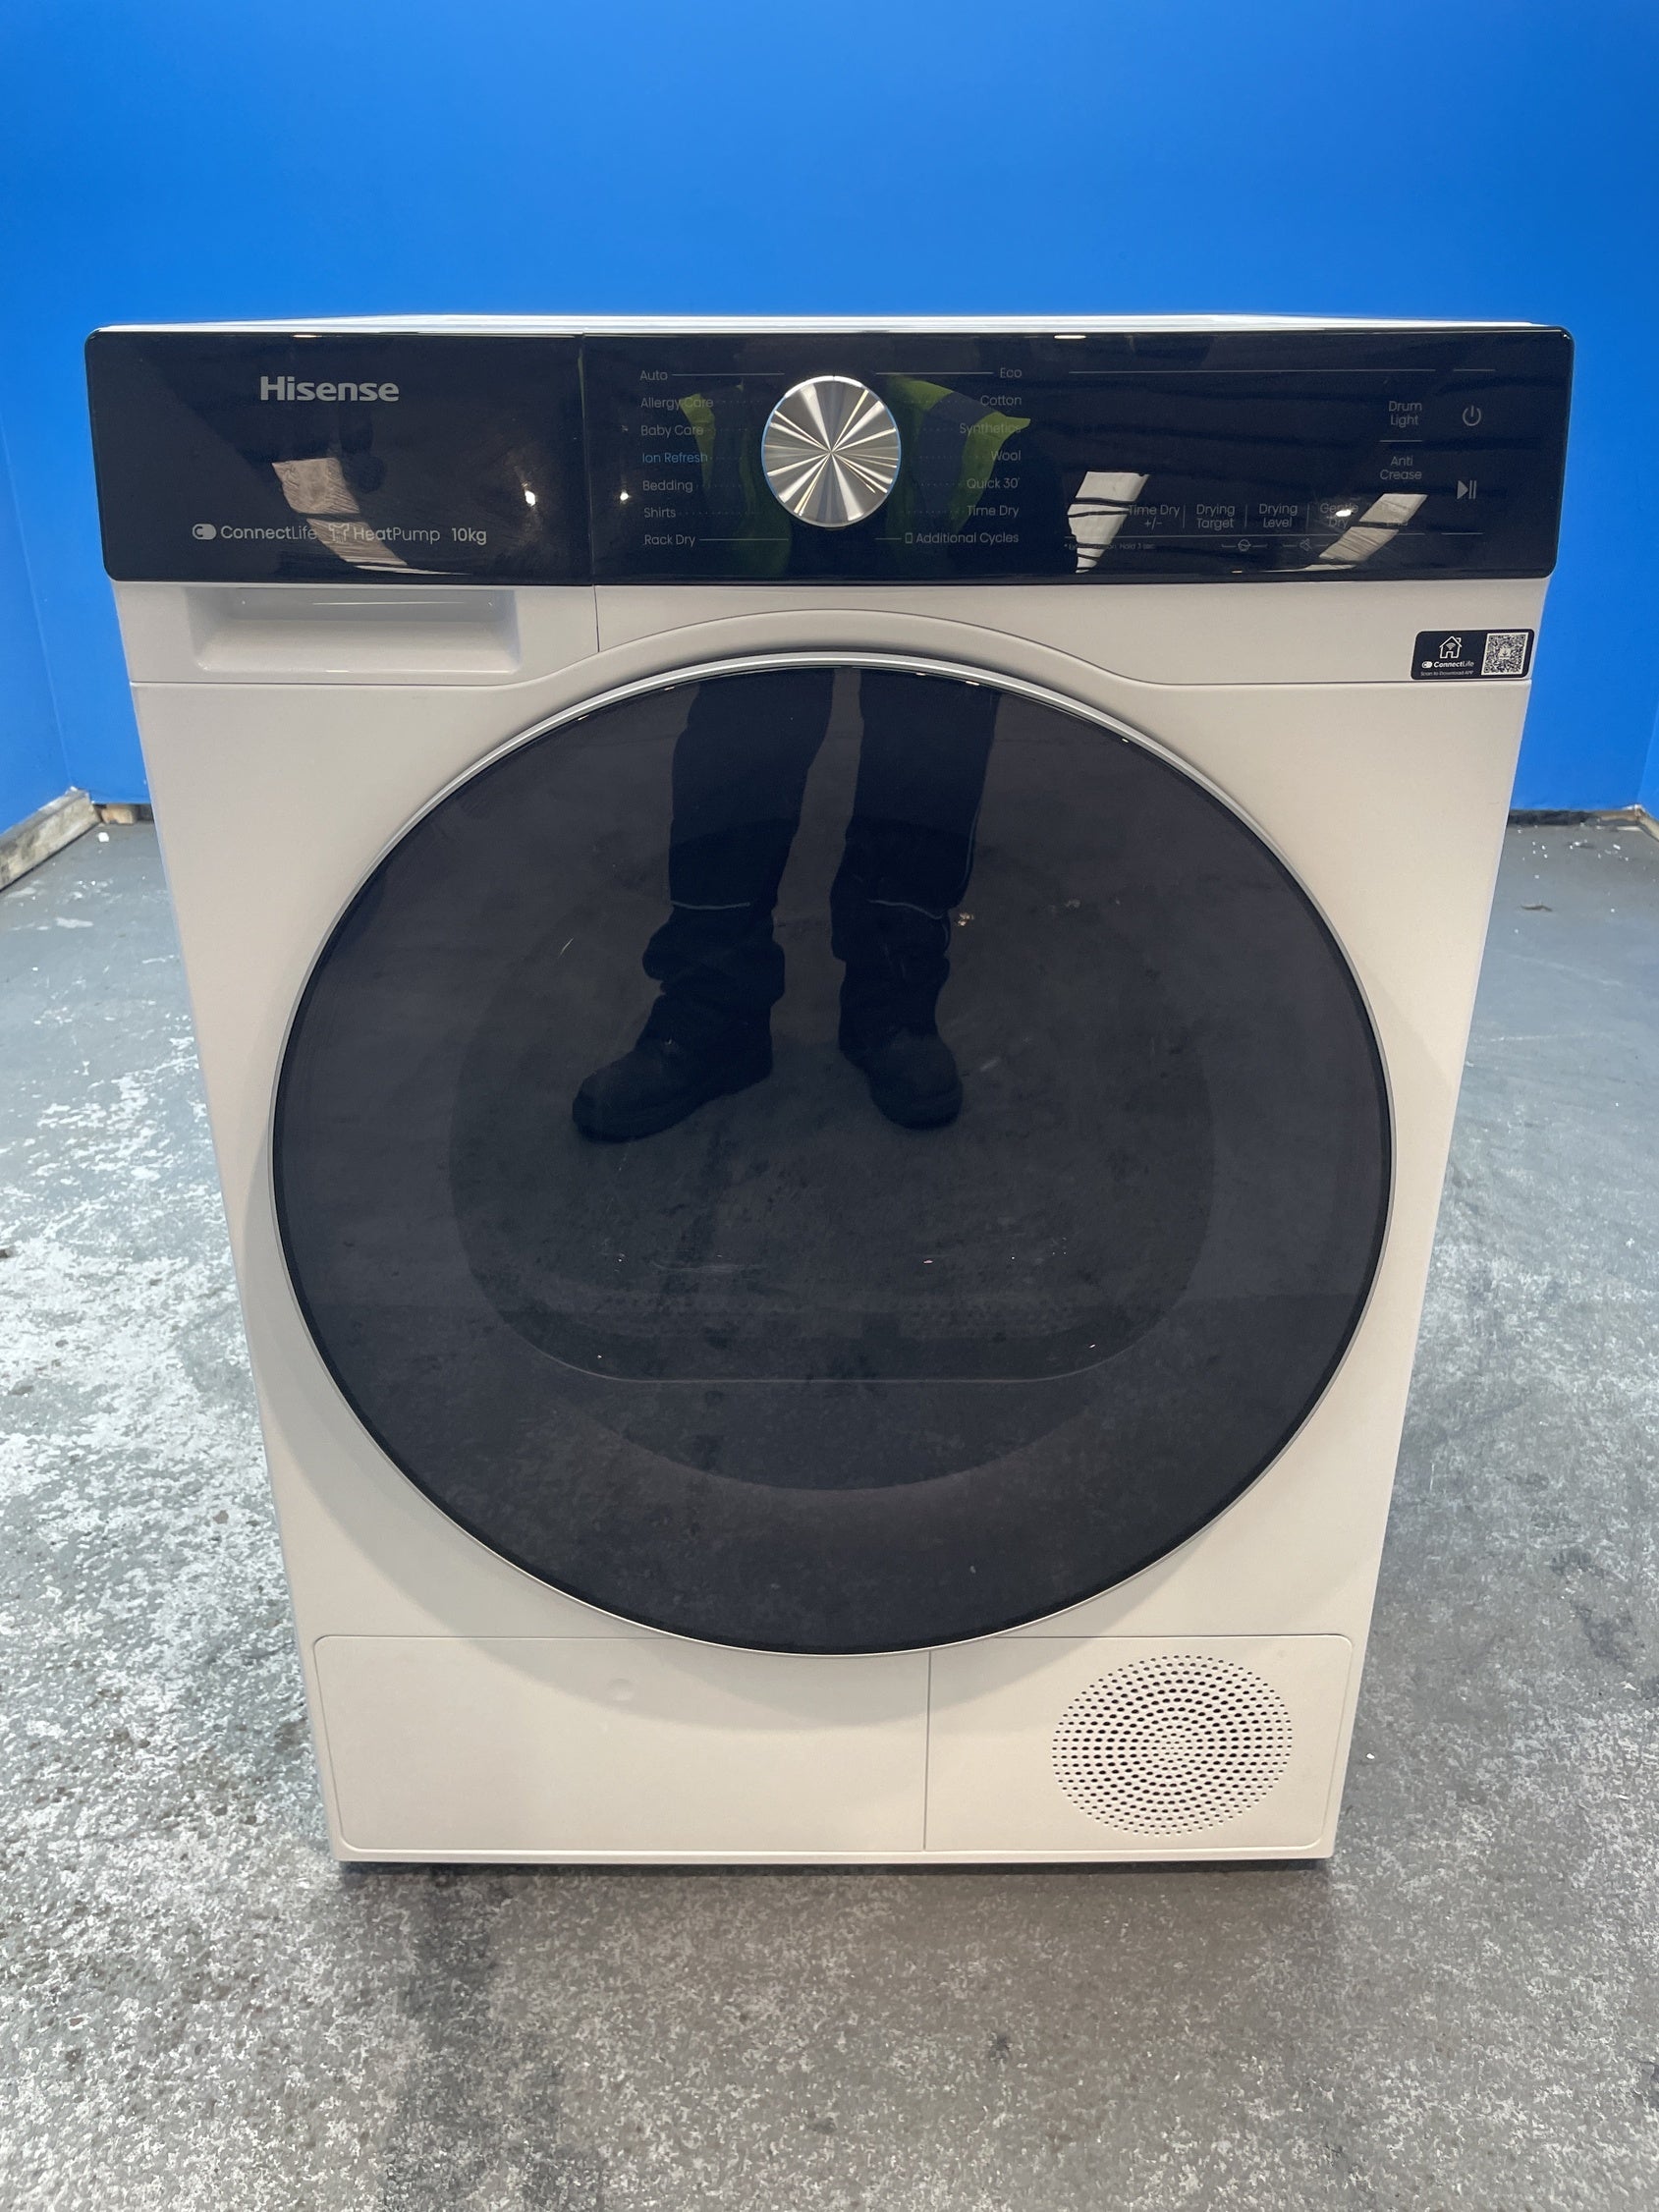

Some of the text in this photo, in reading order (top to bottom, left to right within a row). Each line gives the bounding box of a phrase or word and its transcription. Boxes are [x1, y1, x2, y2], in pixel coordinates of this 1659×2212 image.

[639, 370, 668, 381] Auto
[1000, 367, 1023, 378] Eco
[259, 375, 400, 402] Hisense
[641, 397, 714, 411] Allergy Care
[980, 395, 1022, 407] Cotton
[1388, 401, 1422, 412] Drum
[1390, 415, 1419, 428] Light
[640, 424, 704, 438] Baby Care
[960, 422, 1022, 435] Synthetics
[642, 452, 708, 463] Ion Refresh
[991, 450, 1022, 462] Wool
[1390, 456, 1413, 467] Anti
[1379, 470, 1422, 479] Crease
[642, 479, 693, 493] Bedding
[967, 478, 1000, 489] Quick
[643, 507, 676, 519] Shirts
[967, 505, 1019, 518] Time Dry
[1129, 504, 1181, 518] Time Dry
[1196, 503, 1236, 517] Drying
[1258, 503, 1298, 516] Drying
[1197, 518, 1234, 531] Target
[1263, 517, 1293, 527] Level
[1328, 518, 1350, 528] Dry
[220, 525, 487, 545] ConnectLife HeatPump 10kg
[644, 534, 695, 547] Rack Dry
[915, 531, 1019, 545] Additional Cycles
